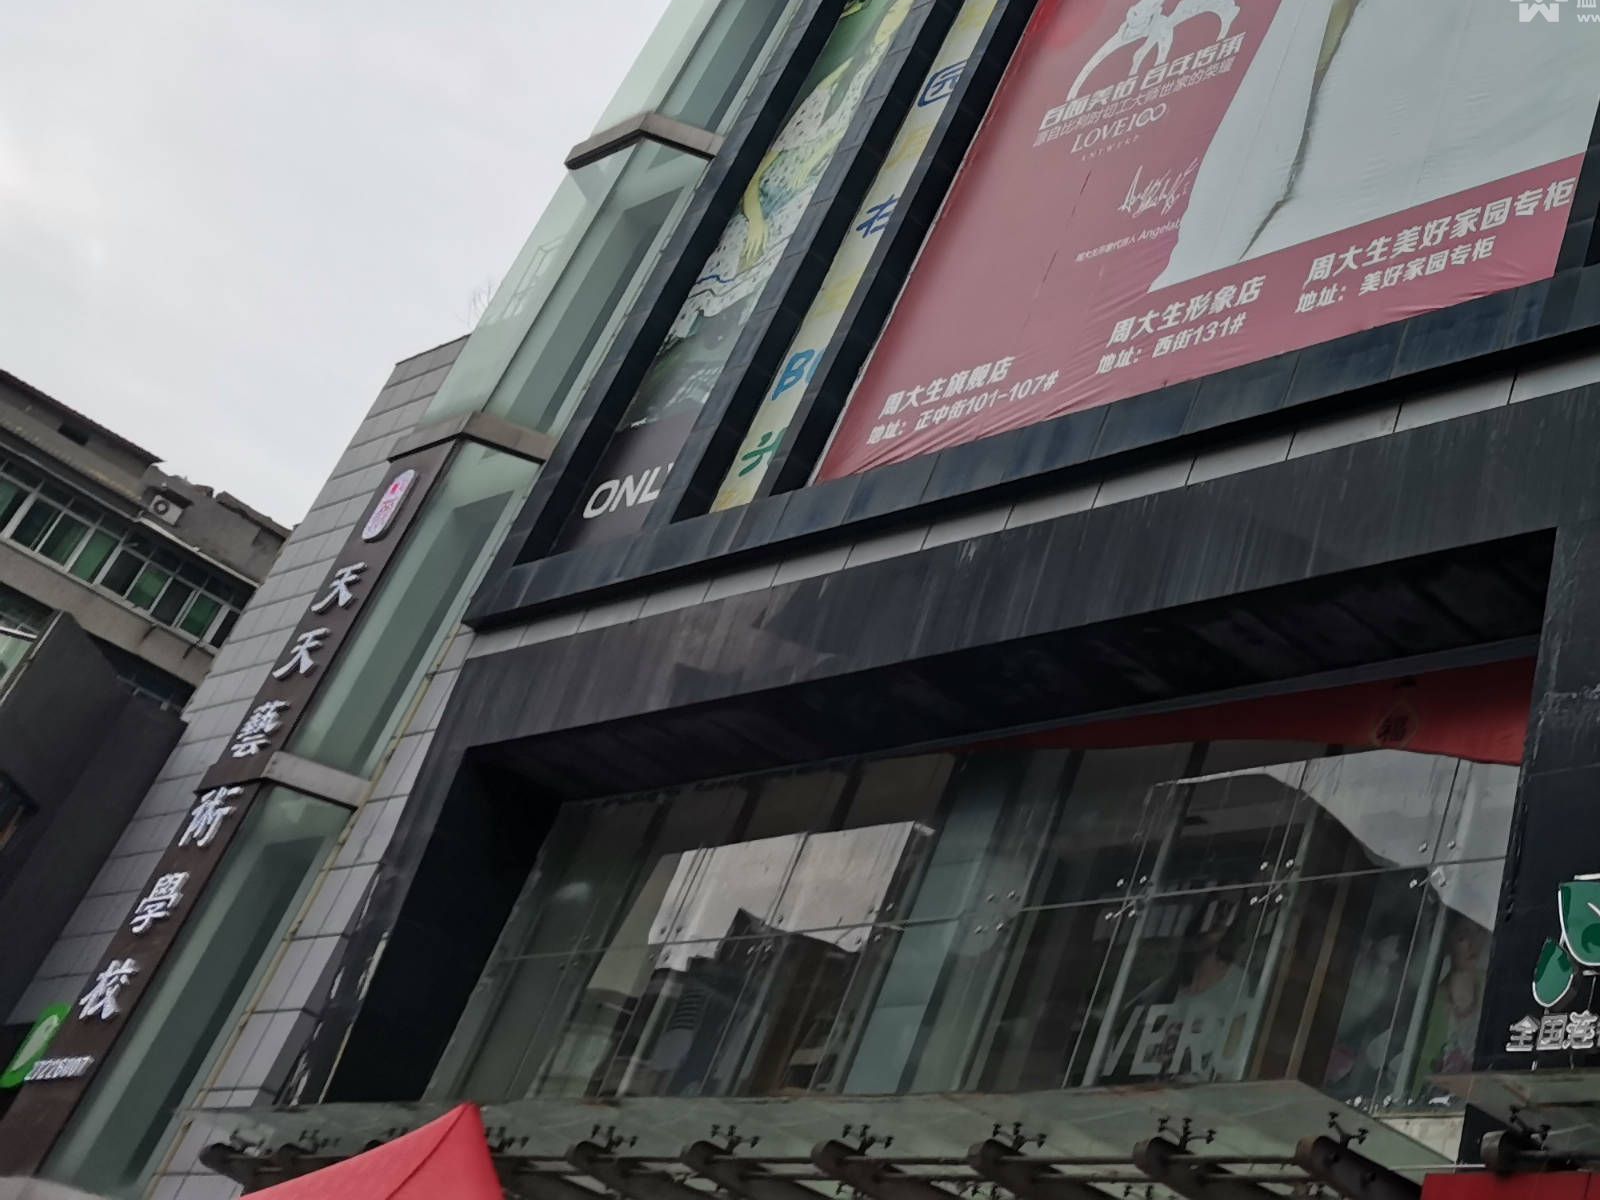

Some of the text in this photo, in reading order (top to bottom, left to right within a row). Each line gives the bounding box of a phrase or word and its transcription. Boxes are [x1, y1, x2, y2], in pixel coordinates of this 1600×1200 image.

[1302, 176, 1577, 288] 周大生美好家园专柜
[1105, 274, 1267, 348] 周大生形象店
[878, 355, 1016, 420] 周大生旗舰店
